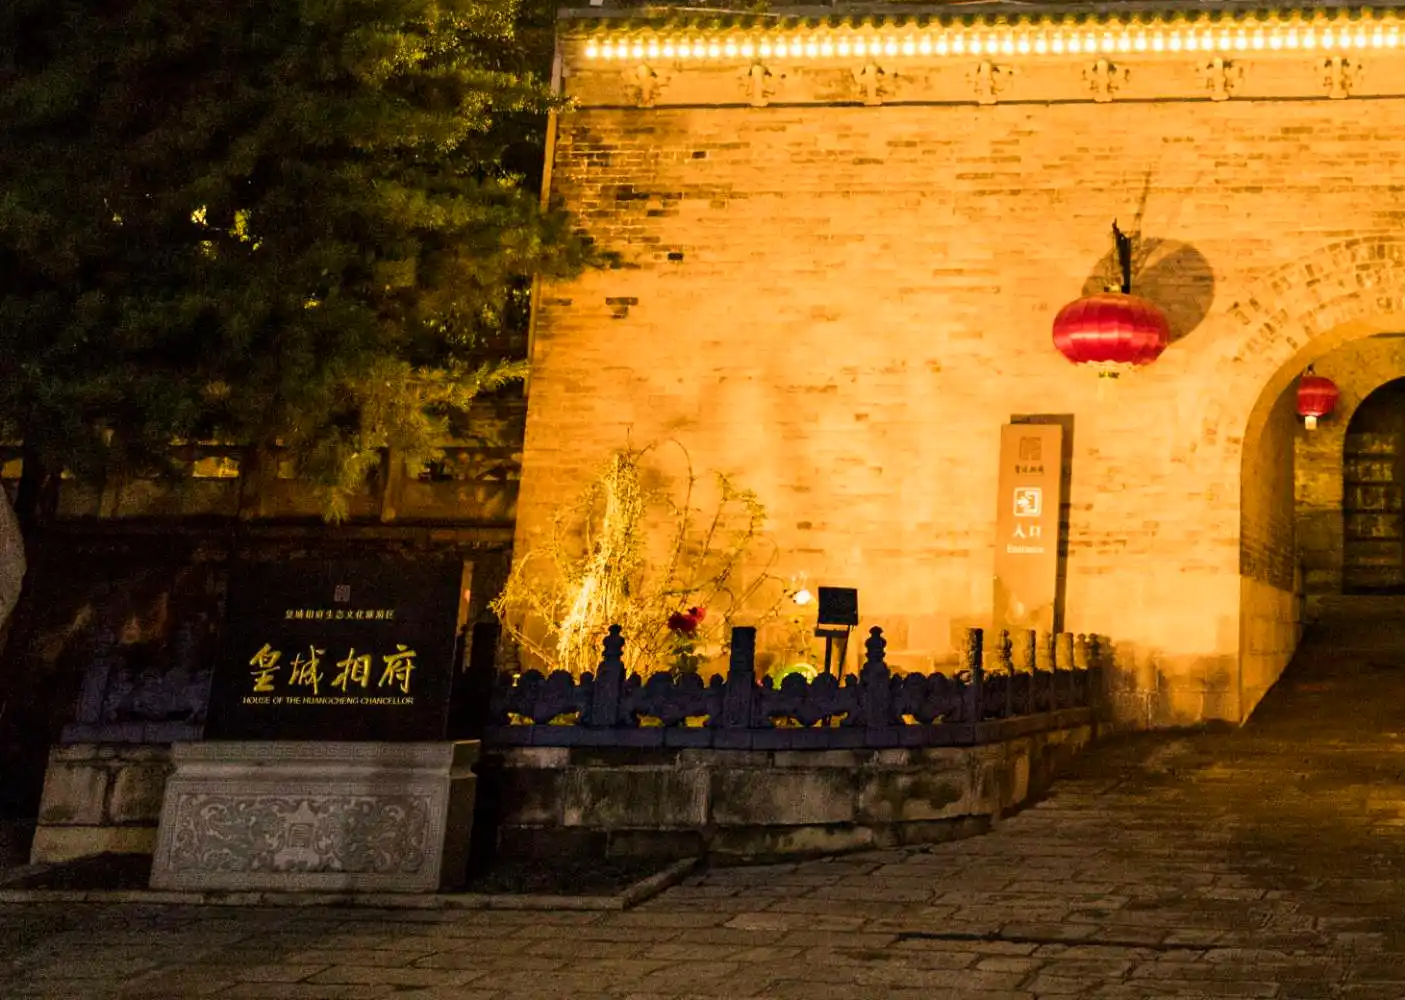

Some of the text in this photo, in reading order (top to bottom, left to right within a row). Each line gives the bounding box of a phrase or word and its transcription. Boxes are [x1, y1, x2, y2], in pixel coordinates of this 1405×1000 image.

[1011, 522, 1041, 539] 入口
[249, 642, 417, 695] 皇城相府
[242, 696, 414, 705] HOUSE OF THE HUANGCHENG CHANCELLOR
